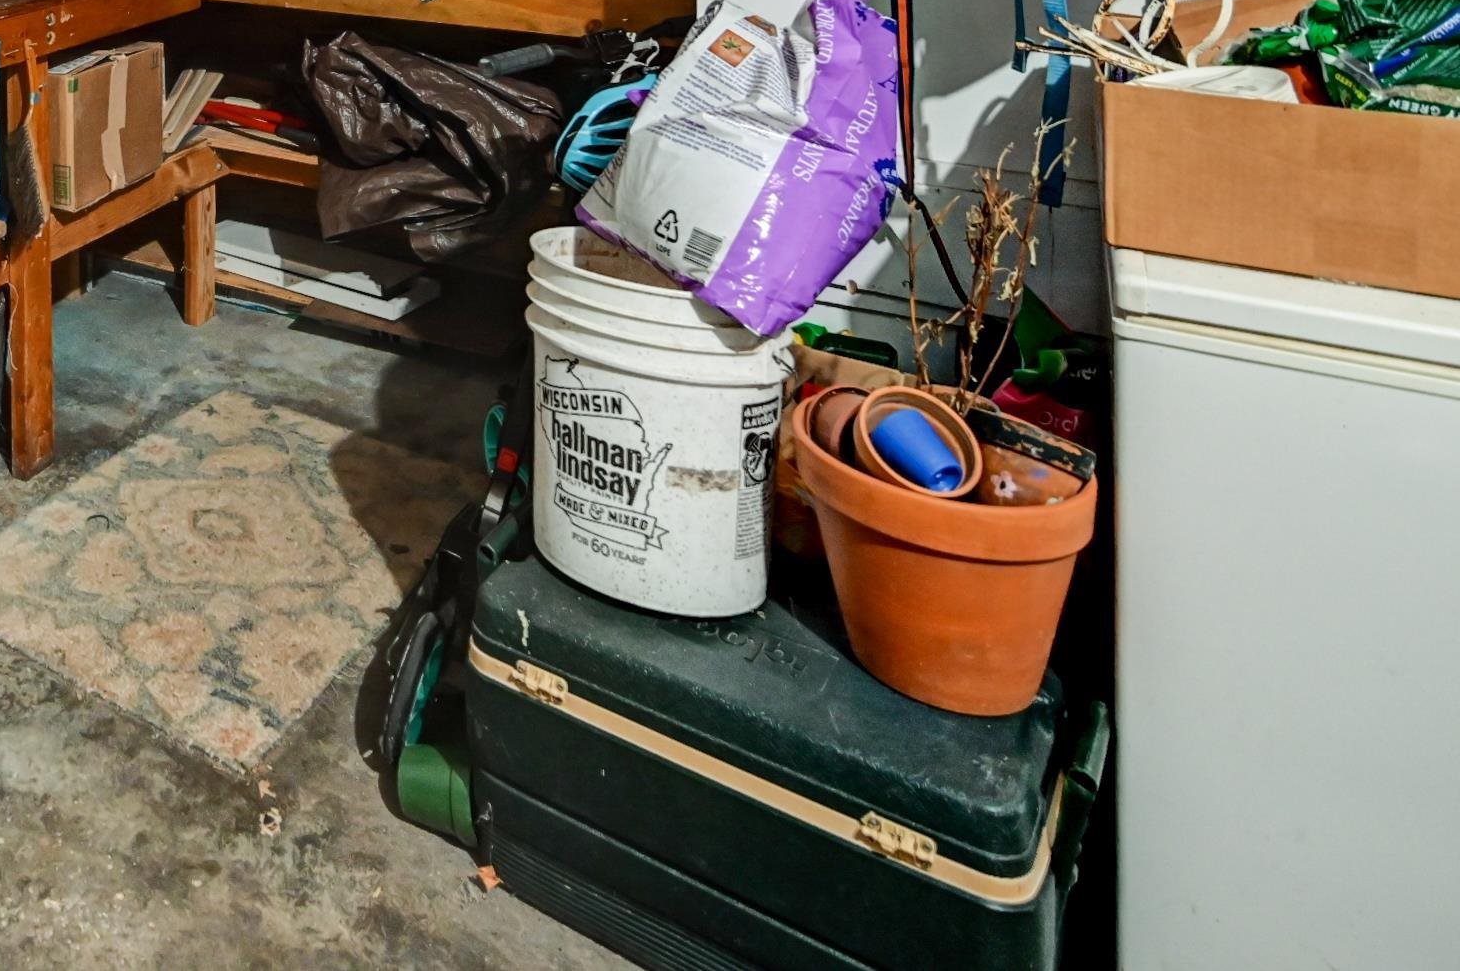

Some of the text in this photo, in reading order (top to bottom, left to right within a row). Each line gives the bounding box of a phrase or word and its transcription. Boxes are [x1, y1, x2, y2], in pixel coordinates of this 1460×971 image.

[845, 74, 878, 156] ATURAL
[1388, 97, 1441, 116] GREEN
[837, 168, 878, 247] RGANIC
[541, 385, 623, 415] WISCONSIN
[551, 410, 642, 474] hallman
[556, 439, 642, 507] lindsay
[559, 493, 586, 515] MADE
[608, 510, 650, 531] MIXED
[571, 531, 590, 547] FOR
[590, 538, 611, 558] 60
